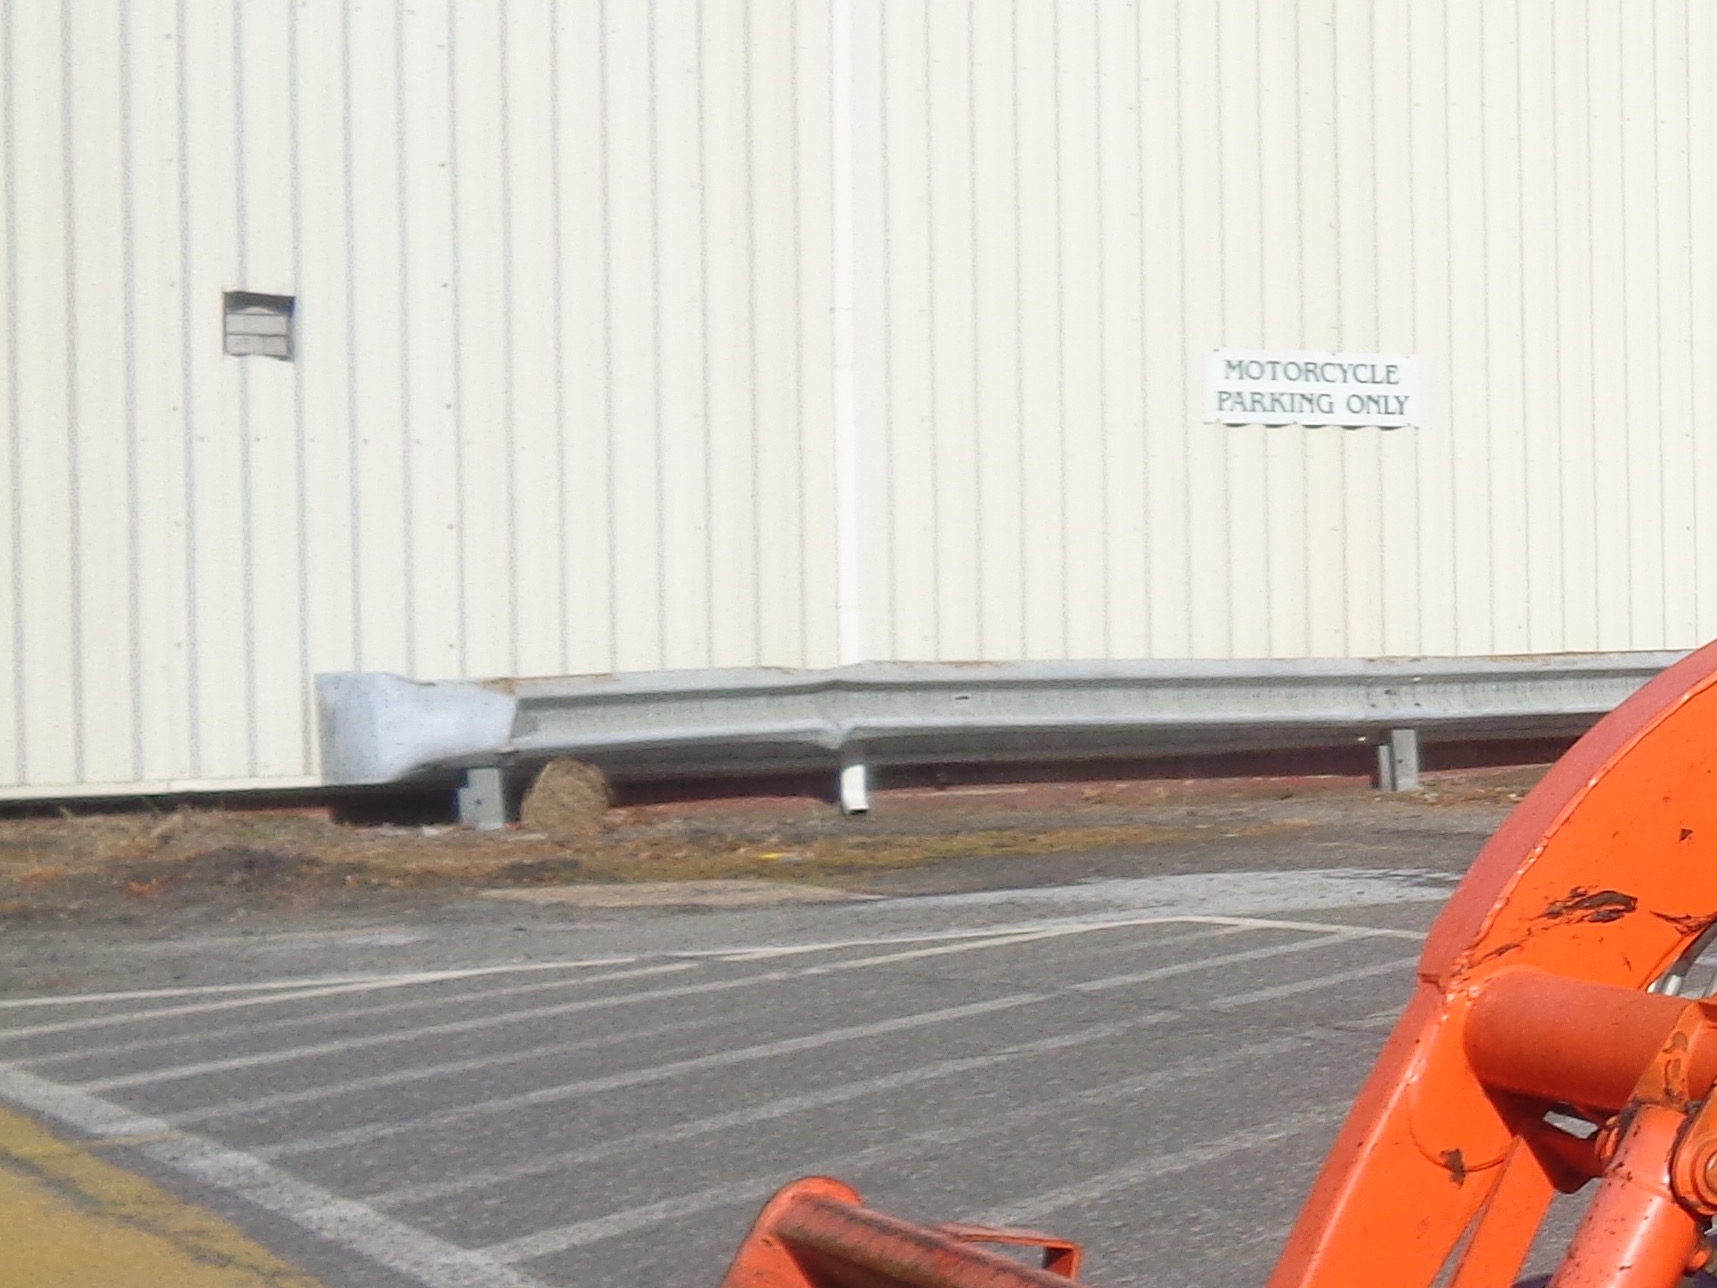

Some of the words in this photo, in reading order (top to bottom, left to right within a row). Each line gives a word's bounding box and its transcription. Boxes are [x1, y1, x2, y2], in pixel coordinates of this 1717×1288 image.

[1223, 360, 1400, 385] MOTORCYCLE
[1217, 391, 1334, 414] PARKING
[1346, 394, 1410, 415] ONLY
